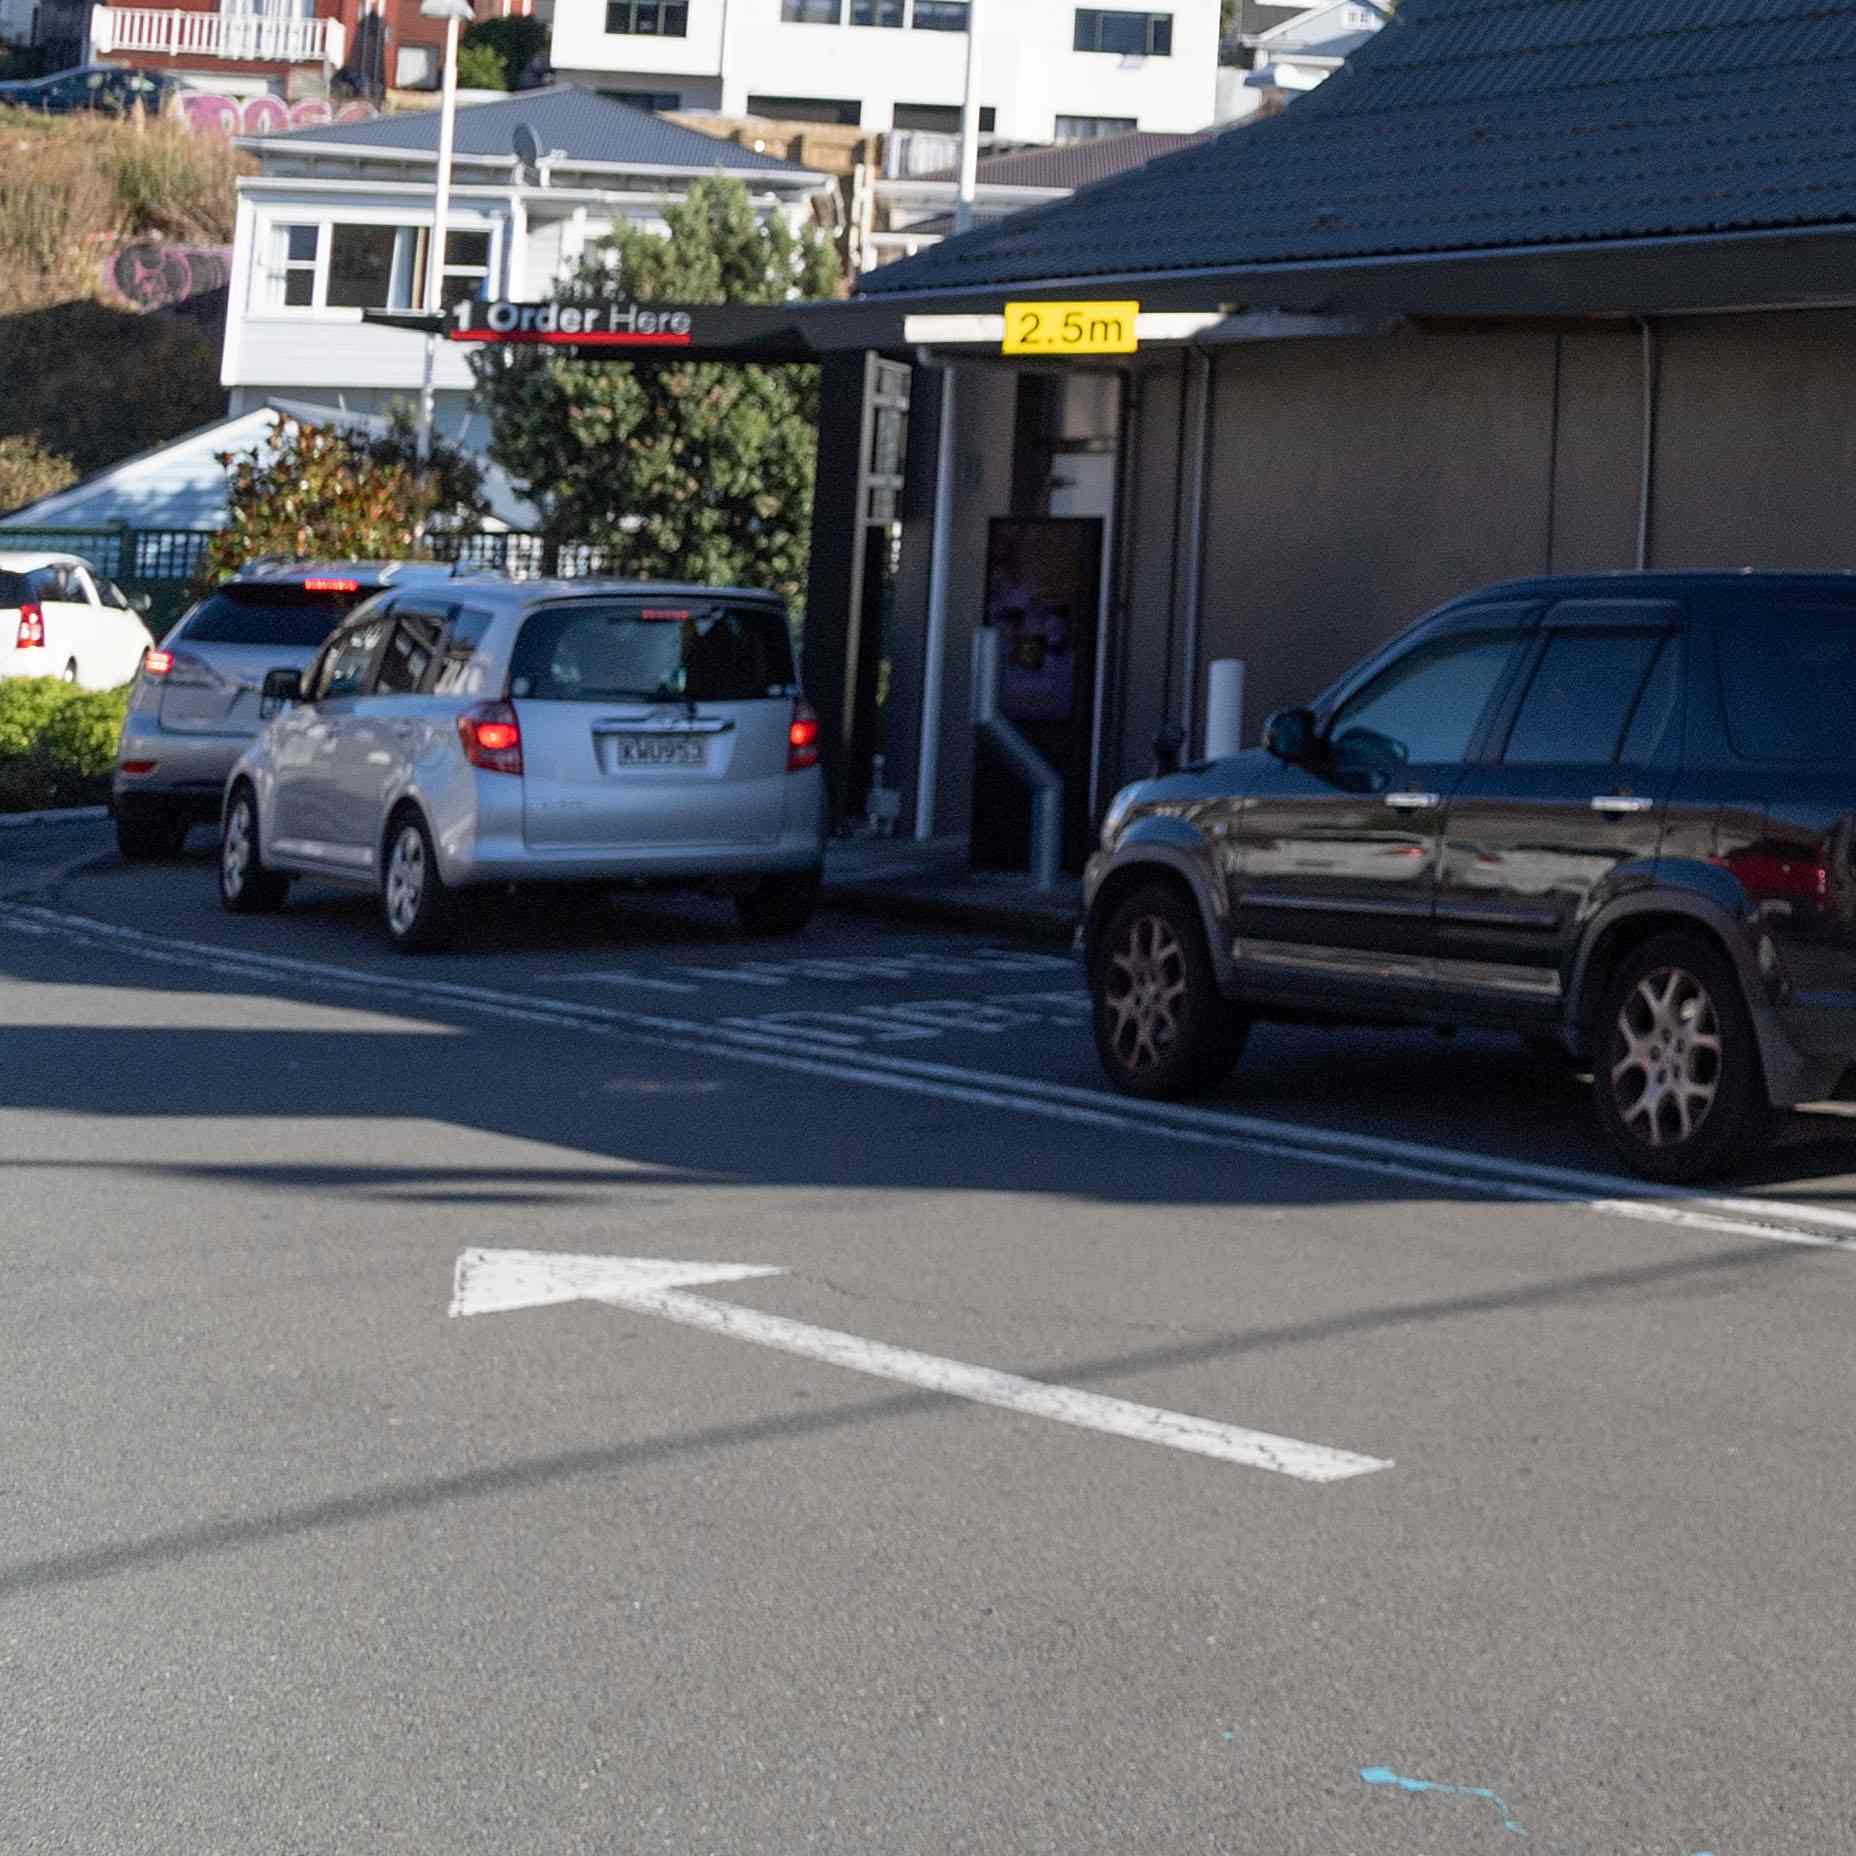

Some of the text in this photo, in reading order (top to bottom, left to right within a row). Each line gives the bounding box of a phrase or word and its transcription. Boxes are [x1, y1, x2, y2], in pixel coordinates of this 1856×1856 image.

[486, 300, 600, 334] Order
[608, 302, 692, 334] Here
[1020, 312, 1123, 344] 2.5m
